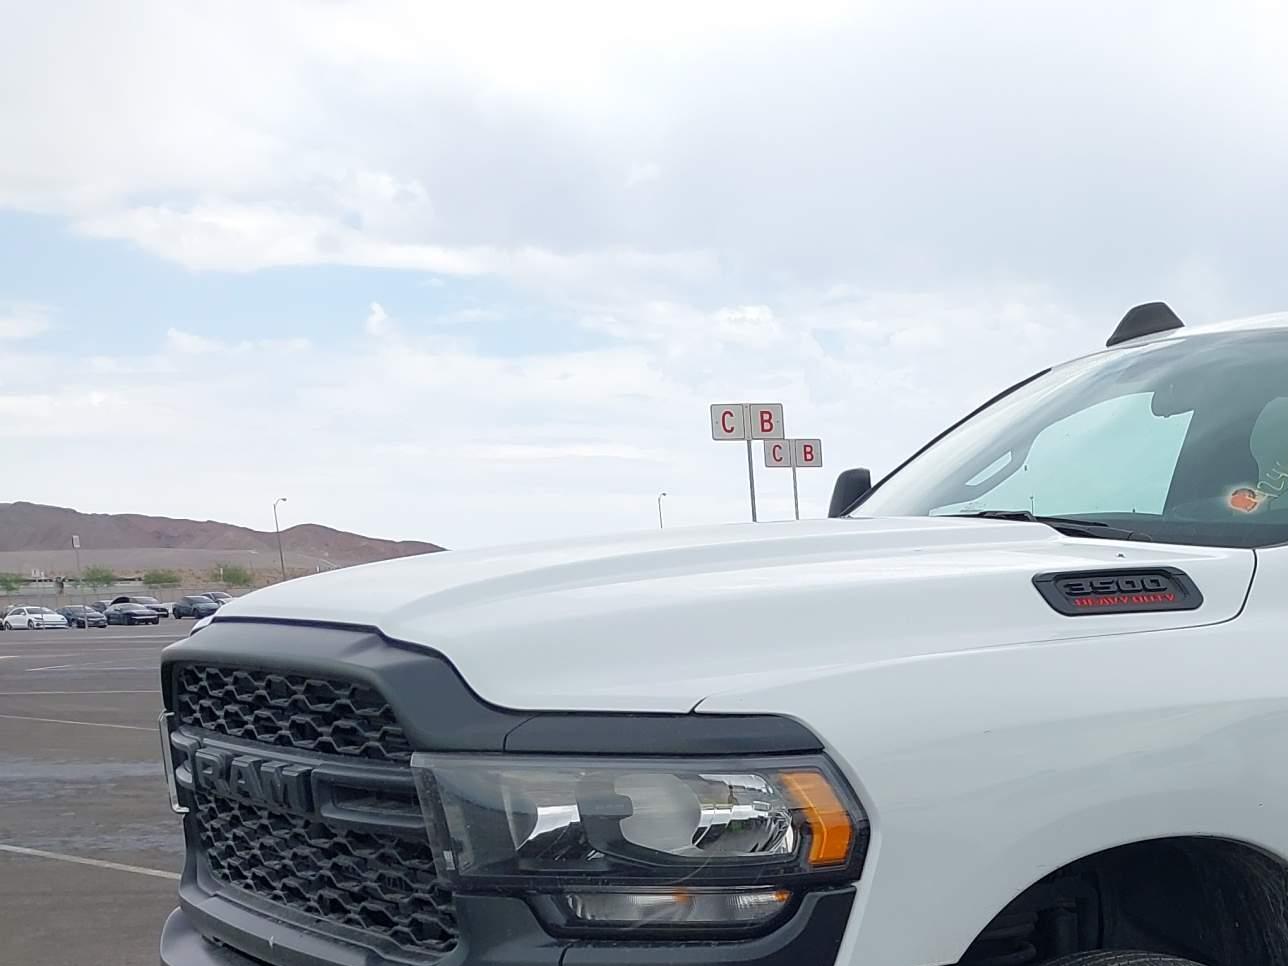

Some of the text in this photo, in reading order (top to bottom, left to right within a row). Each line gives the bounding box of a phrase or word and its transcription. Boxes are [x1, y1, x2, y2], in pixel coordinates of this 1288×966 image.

[721, 410, 774, 433] C B
[772, 444, 814, 462] C B
[1064, 576, 1168, 597] 3500
[195, 748, 315, 814] RAM
